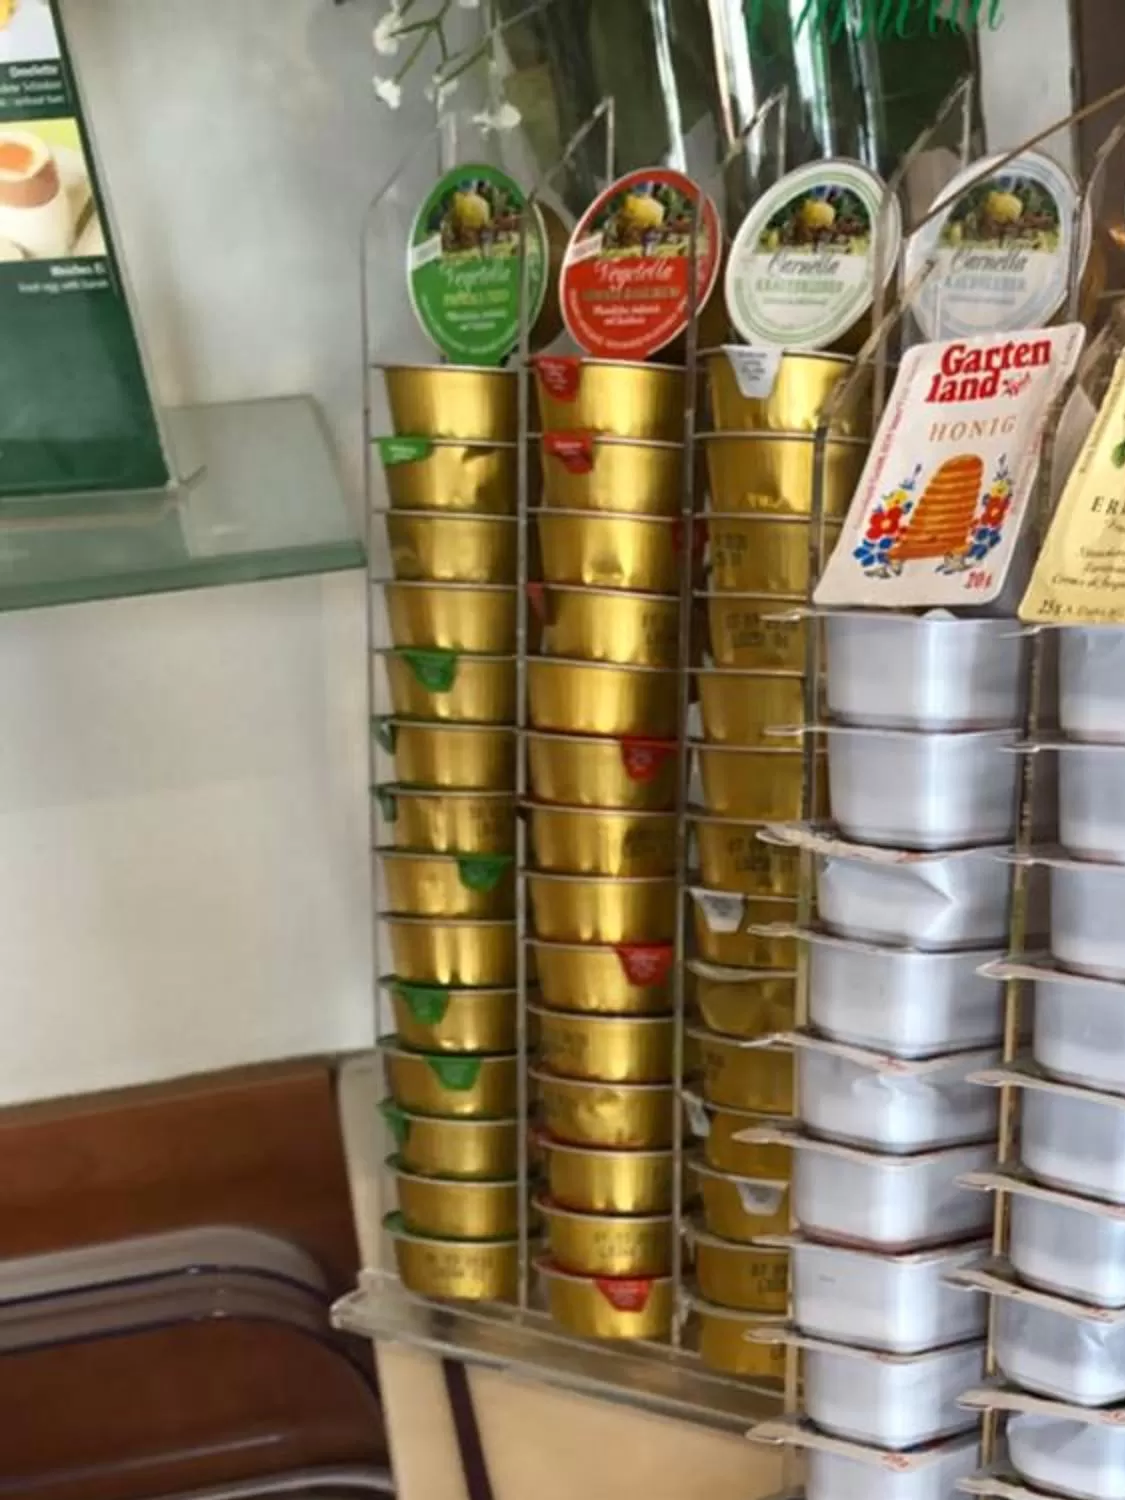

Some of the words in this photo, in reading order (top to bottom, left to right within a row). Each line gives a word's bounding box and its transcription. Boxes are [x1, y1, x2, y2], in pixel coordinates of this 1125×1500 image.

[941, 338, 1052, 378] Garten
[926, 369, 999, 404] land
[928, 415, 1016, 443] HONIG
